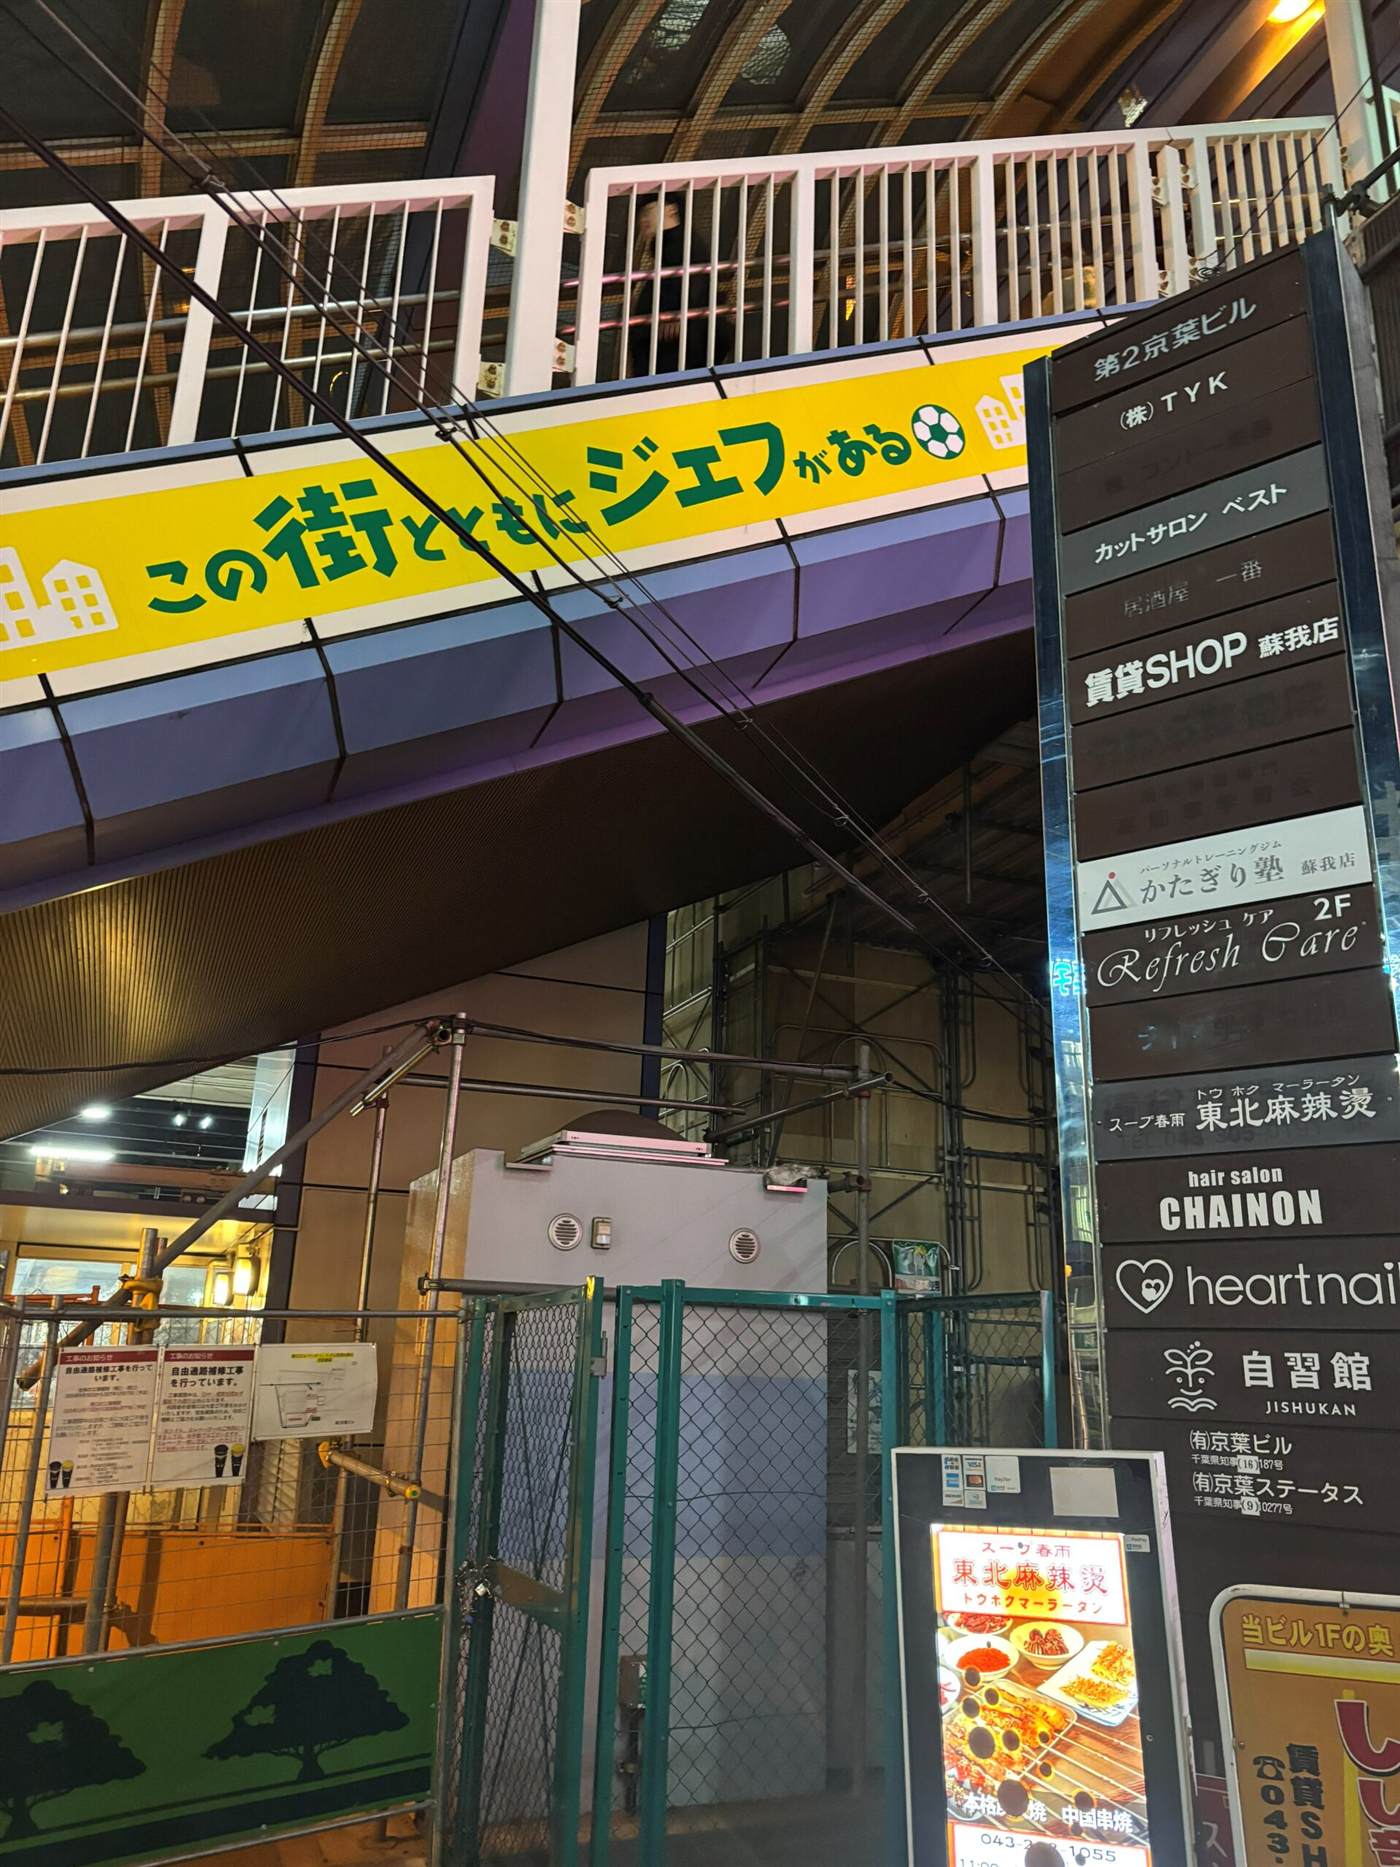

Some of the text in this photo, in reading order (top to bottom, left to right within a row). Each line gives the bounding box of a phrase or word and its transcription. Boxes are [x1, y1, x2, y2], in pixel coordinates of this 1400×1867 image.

[1094, 297, 1257, 381] 第2京葉ビル
[146, 421, 912, 613] この街とともにジェフがある
[1094, 482, 1287, 564] カットサロン ベスト
[1085, 616, 1339, 707] 賃貸SHOP 蘇我店
[1140, 851, 1356, 904] かたぎり塾 蘇我店
[1144, 909, 1274, 943] リフレッシュ ケア
[1313, 893, 1352, 922] 2F
[1096, 933, 1241, 992] Refresh
[1261, 922, 1358, 963] Care
[1195, 1074, 1360, 1101] トウ ホク マーラータン
[1109, 1111, 1186, 1133] スープ春雨
[1188, 1167, 1284, 1188] hair salon
[1159, 1189, 1324, 1232] CHAINON
[1241, 1350, 1373, 1392] 自習館
[1265, 1400, 1357, 1416] JISHUKAN
